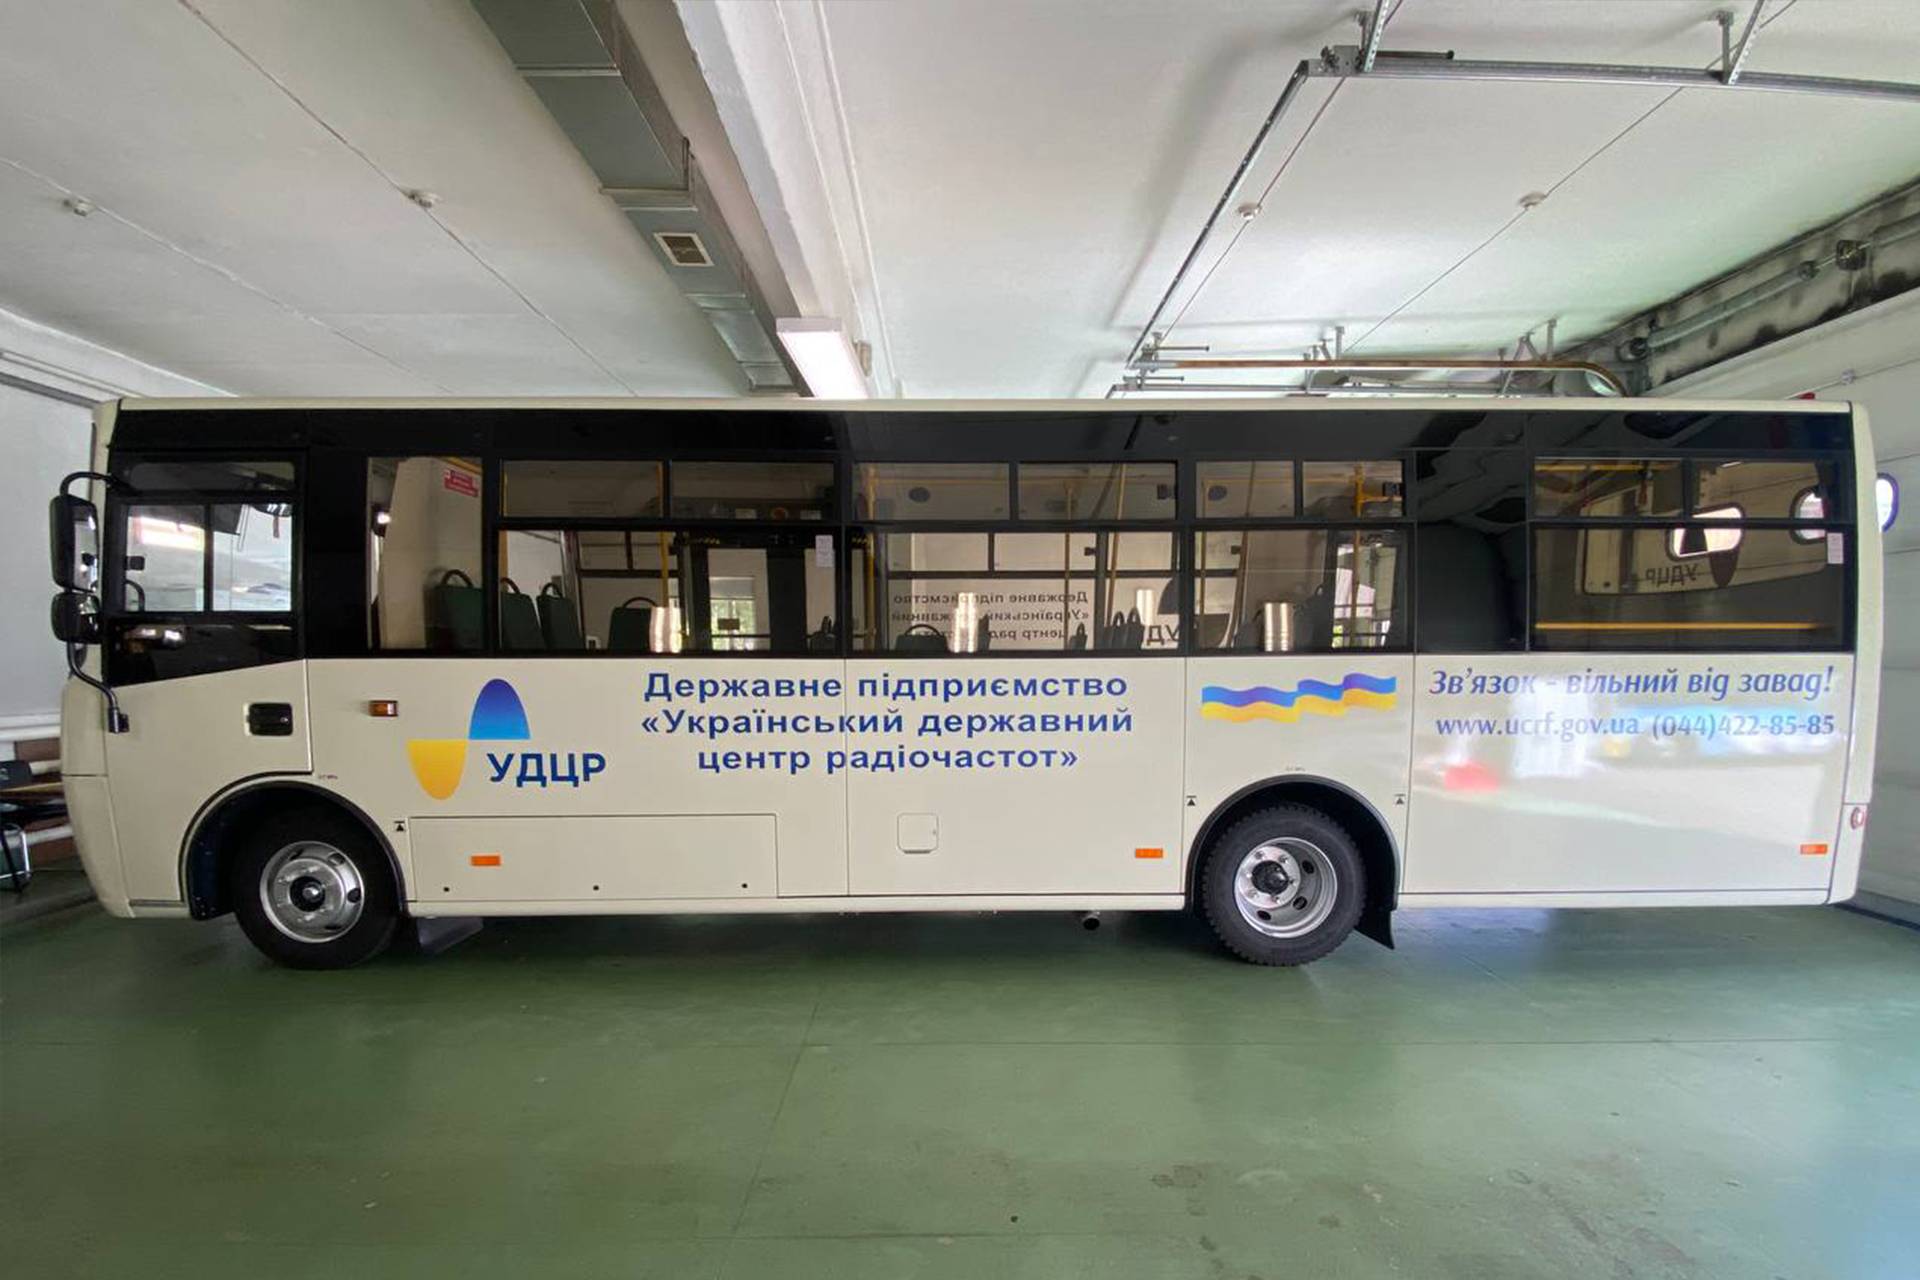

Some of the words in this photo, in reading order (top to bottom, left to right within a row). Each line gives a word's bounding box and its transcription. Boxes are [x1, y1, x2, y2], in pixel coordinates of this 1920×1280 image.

[644, 672, 842, 703] Державне
[858, 672, 1128, 703] підприємство
[1565, 667, 1679, 694] вільний
[1687, 666, 1730, 701] від
[1737, 665, 1835, 701] завад!
[642, 708, 903, 739] «Український
[917, 708, 1132, 738] державний
[1436, 711, 1640, 742] www.ucrf.gov.ua
[1652, 713, 1835, 741] (044)422-85-85
[487, 752, 606, 788] УДЦР
[699, 751, 811, 775] центр
[827, 745, 1078, 775] радіочастот»
